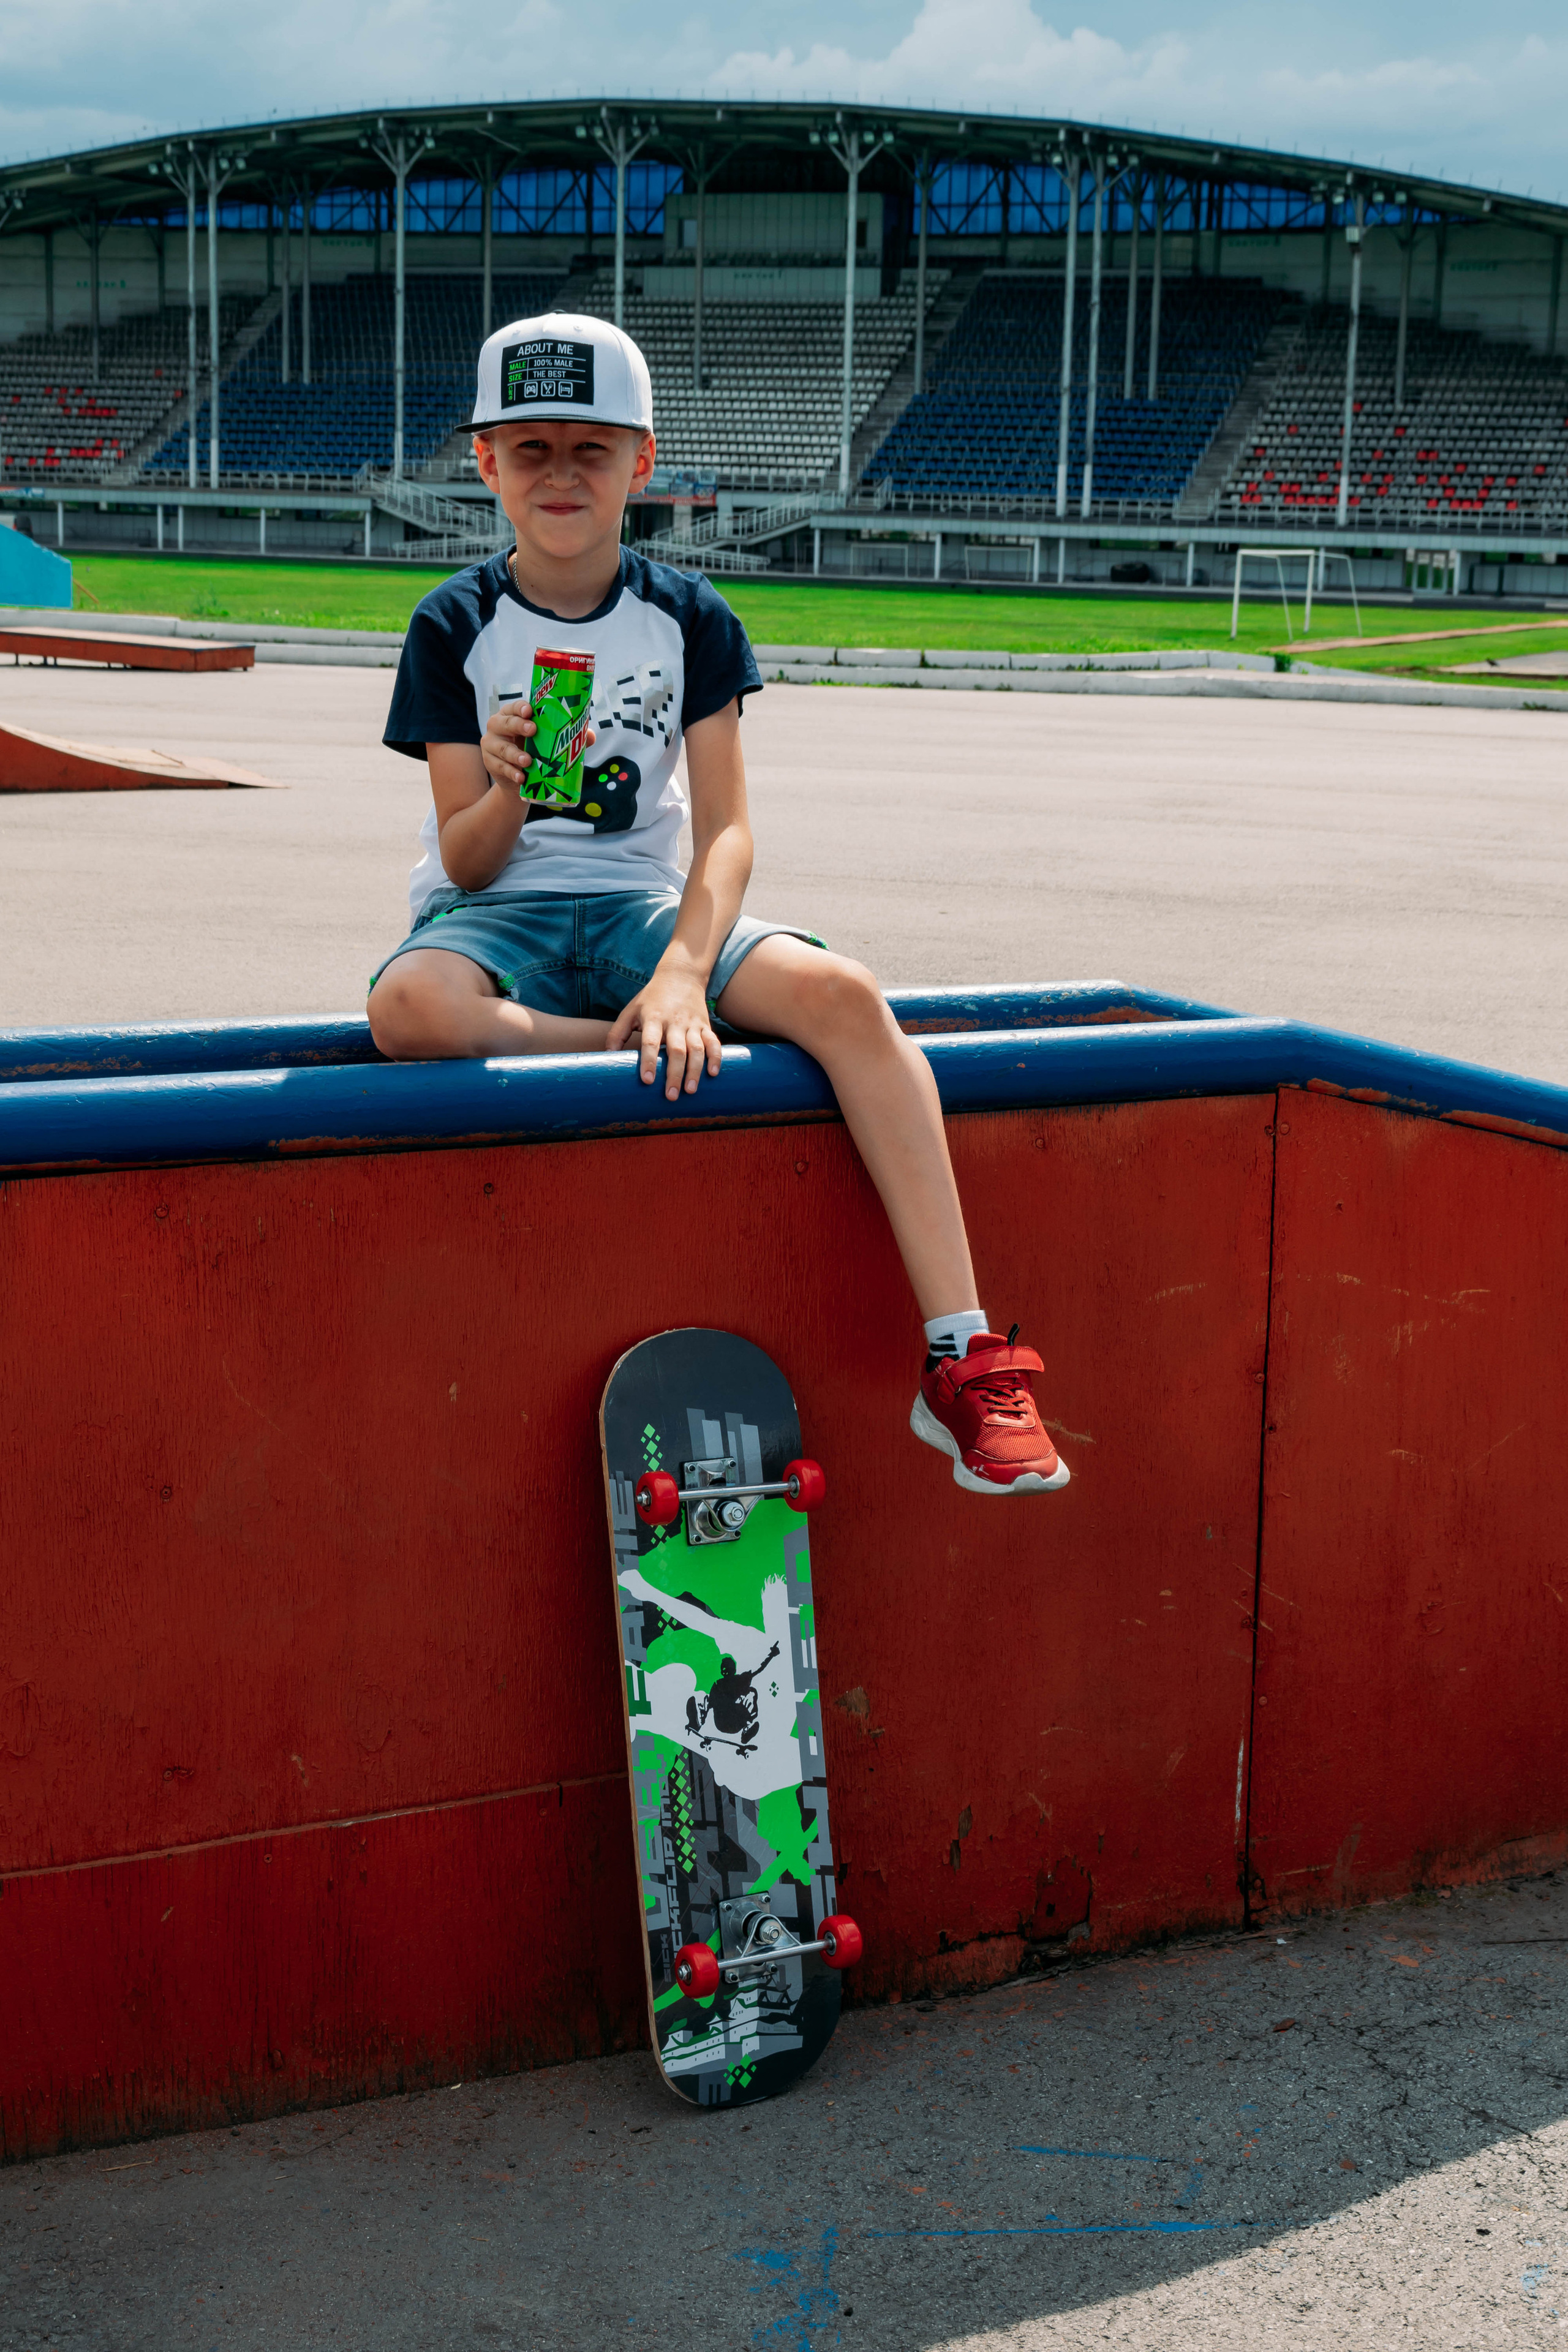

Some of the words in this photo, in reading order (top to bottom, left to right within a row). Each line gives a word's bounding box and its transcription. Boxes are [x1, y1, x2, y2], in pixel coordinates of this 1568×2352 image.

[516, 342, 553, 356] ABOUT
[557, 343, 574, 355] ME
[509, 361, 526, 371] MALE
[554, 359, 573, 368] MALE
[508, 372, 522, 382] SIZE
[660, 1932, 672, 1983] SICK
